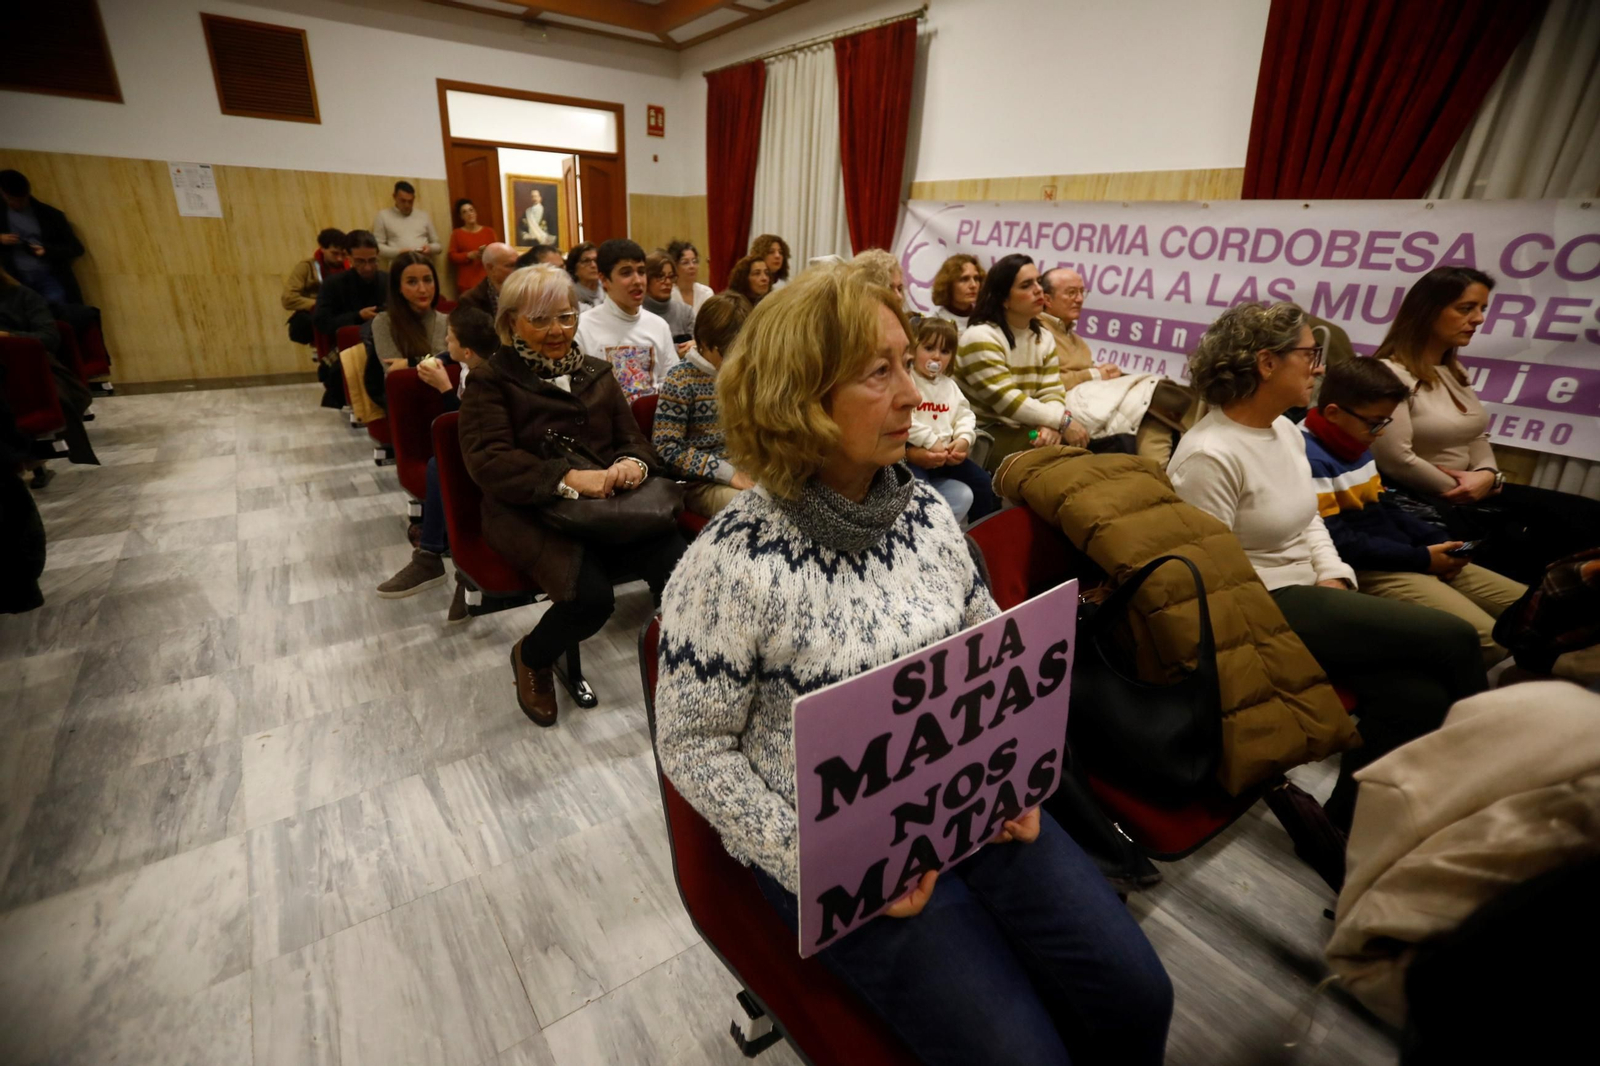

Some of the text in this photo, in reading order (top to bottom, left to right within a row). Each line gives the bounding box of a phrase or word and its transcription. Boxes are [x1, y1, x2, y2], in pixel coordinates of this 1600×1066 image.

[956, 219, 1600, 282] PLATAFORMA CORDOBESA CO
[1164, 270, 1192, 304] A
[1206, 273, 1296, 309] LAS
[1073, 315, 1581, 404] sesin uje
[1096, 347, 1167, 375] CONTRA
[892, 617, 1026, 715] SI LA
[813, 639, 1068, 822] MATAS
[890, 737, 1018, 847] NOS
[815, 748, 1058, 946] MATAS
